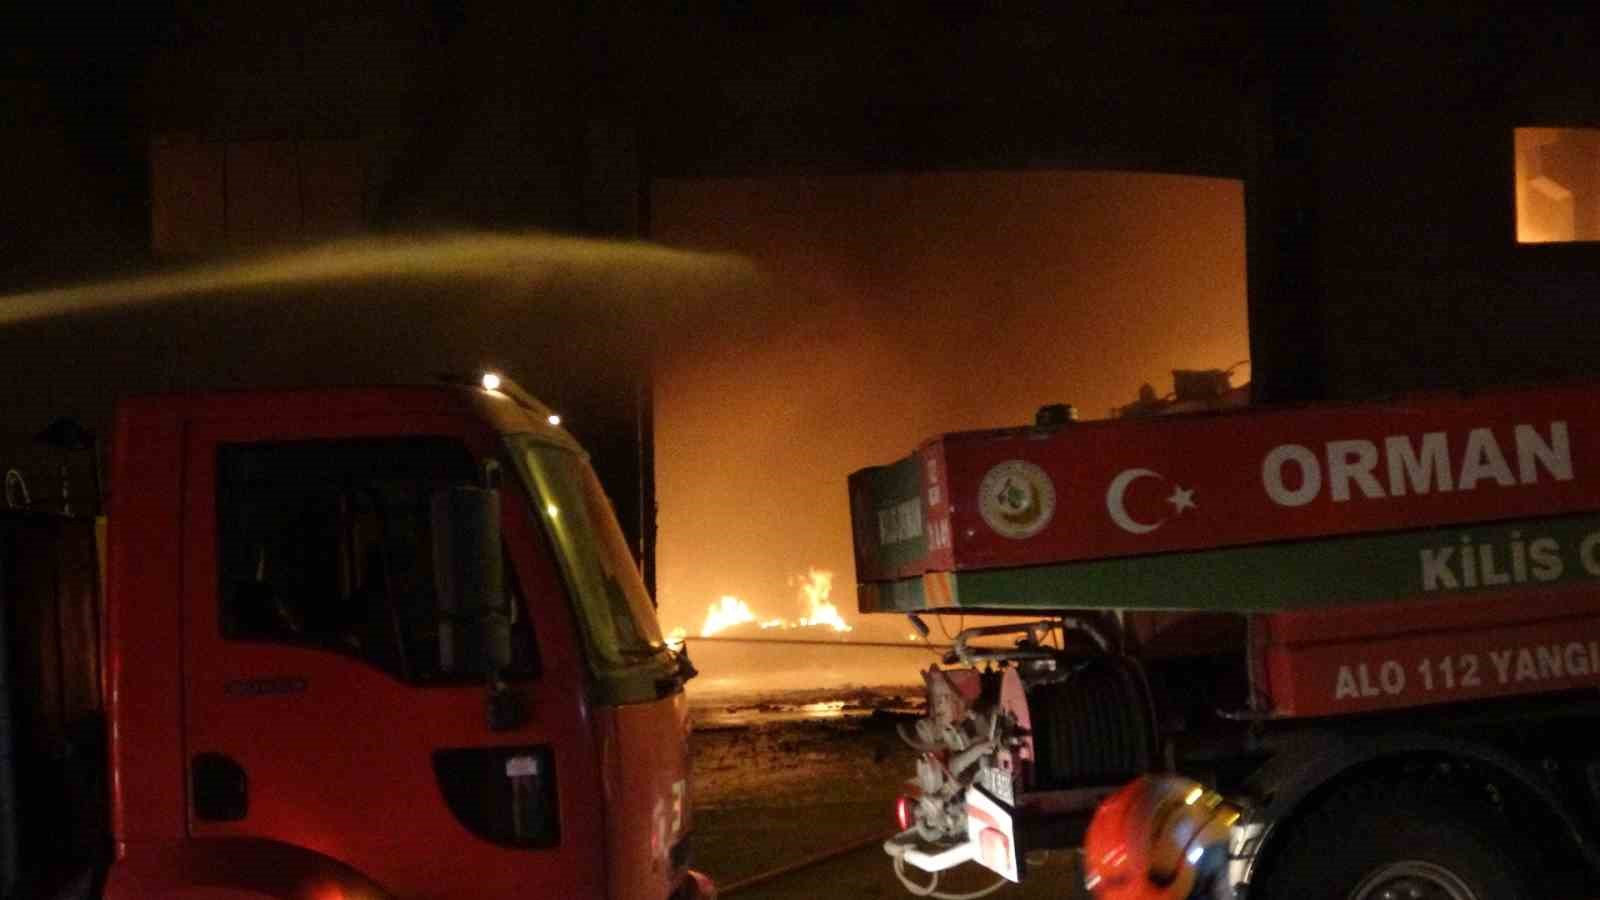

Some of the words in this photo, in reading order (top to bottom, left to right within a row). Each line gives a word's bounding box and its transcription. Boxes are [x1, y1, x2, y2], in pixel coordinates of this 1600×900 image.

[1261, 420, 1575, 508] ORMAN
[1419, 530, 1566, 592] KİLİS
[1335, 659, 1406, 700] ALO
[1417, 654, 1482, 691] 112
